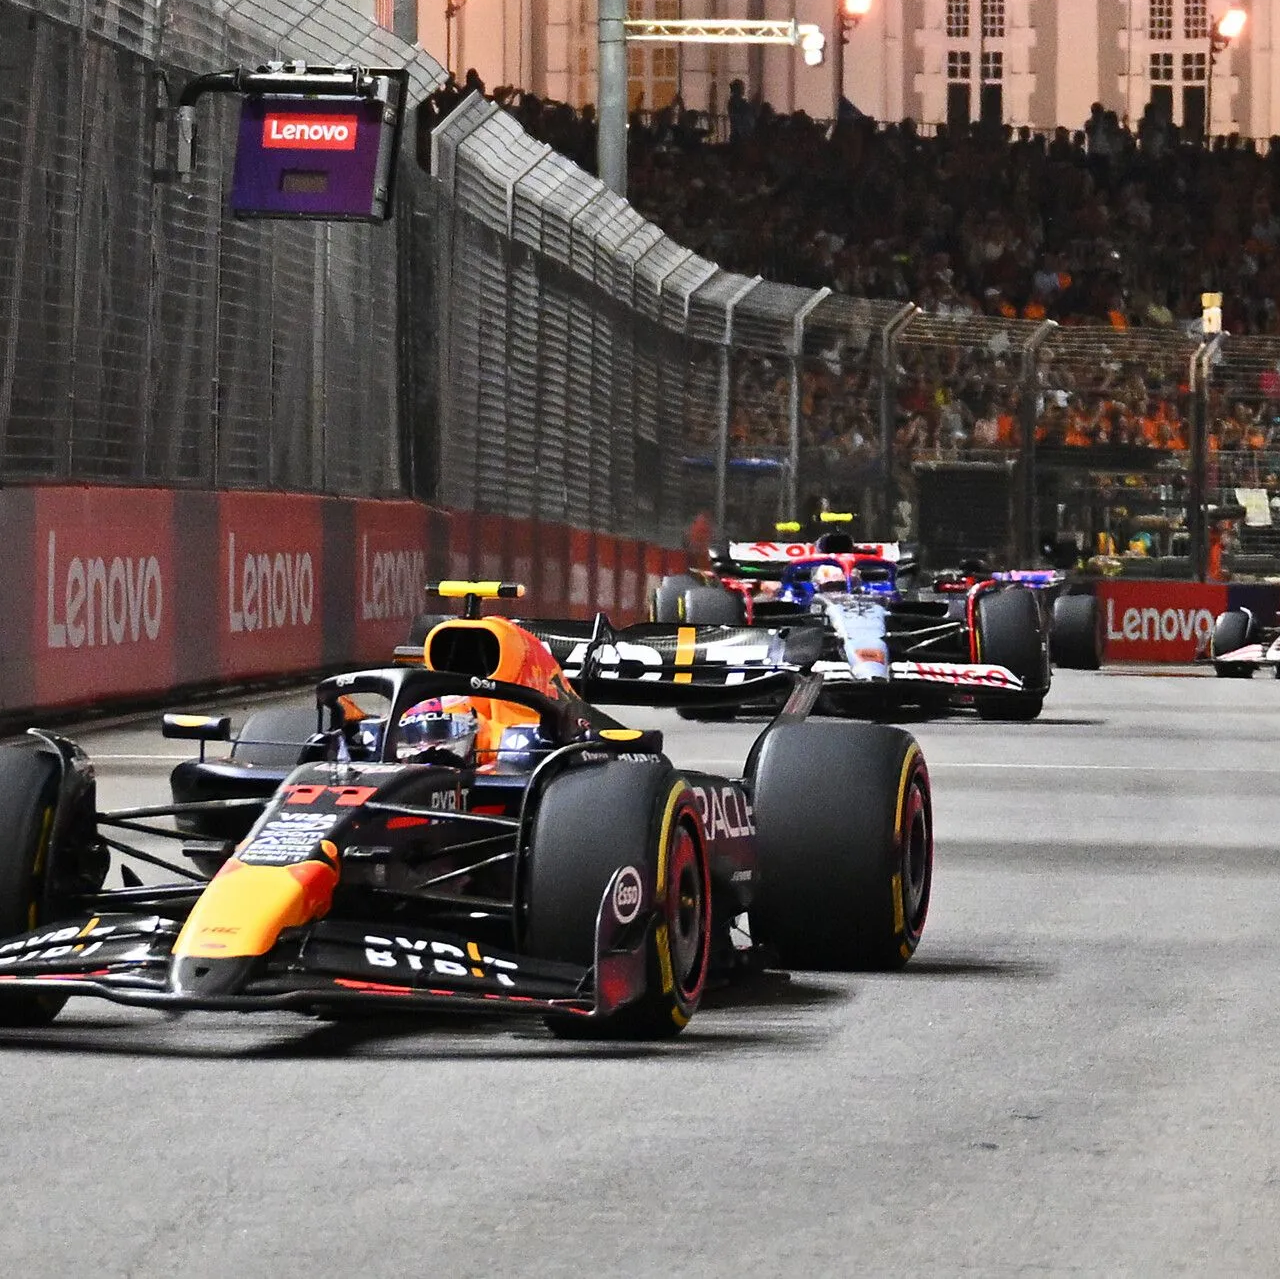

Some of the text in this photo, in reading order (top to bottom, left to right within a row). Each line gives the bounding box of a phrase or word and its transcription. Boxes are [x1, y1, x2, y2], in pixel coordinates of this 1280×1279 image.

[270, 120, 349, 141] Lenovo
[47, 530, 163, 649] Lenovo
[228, 532, 314, 632] Lenovo
[1107, 598, 1215, 641] Lenovo
[398, 712, 452, 727] ORACLE
[692, 785, 756, 841] RACLE
